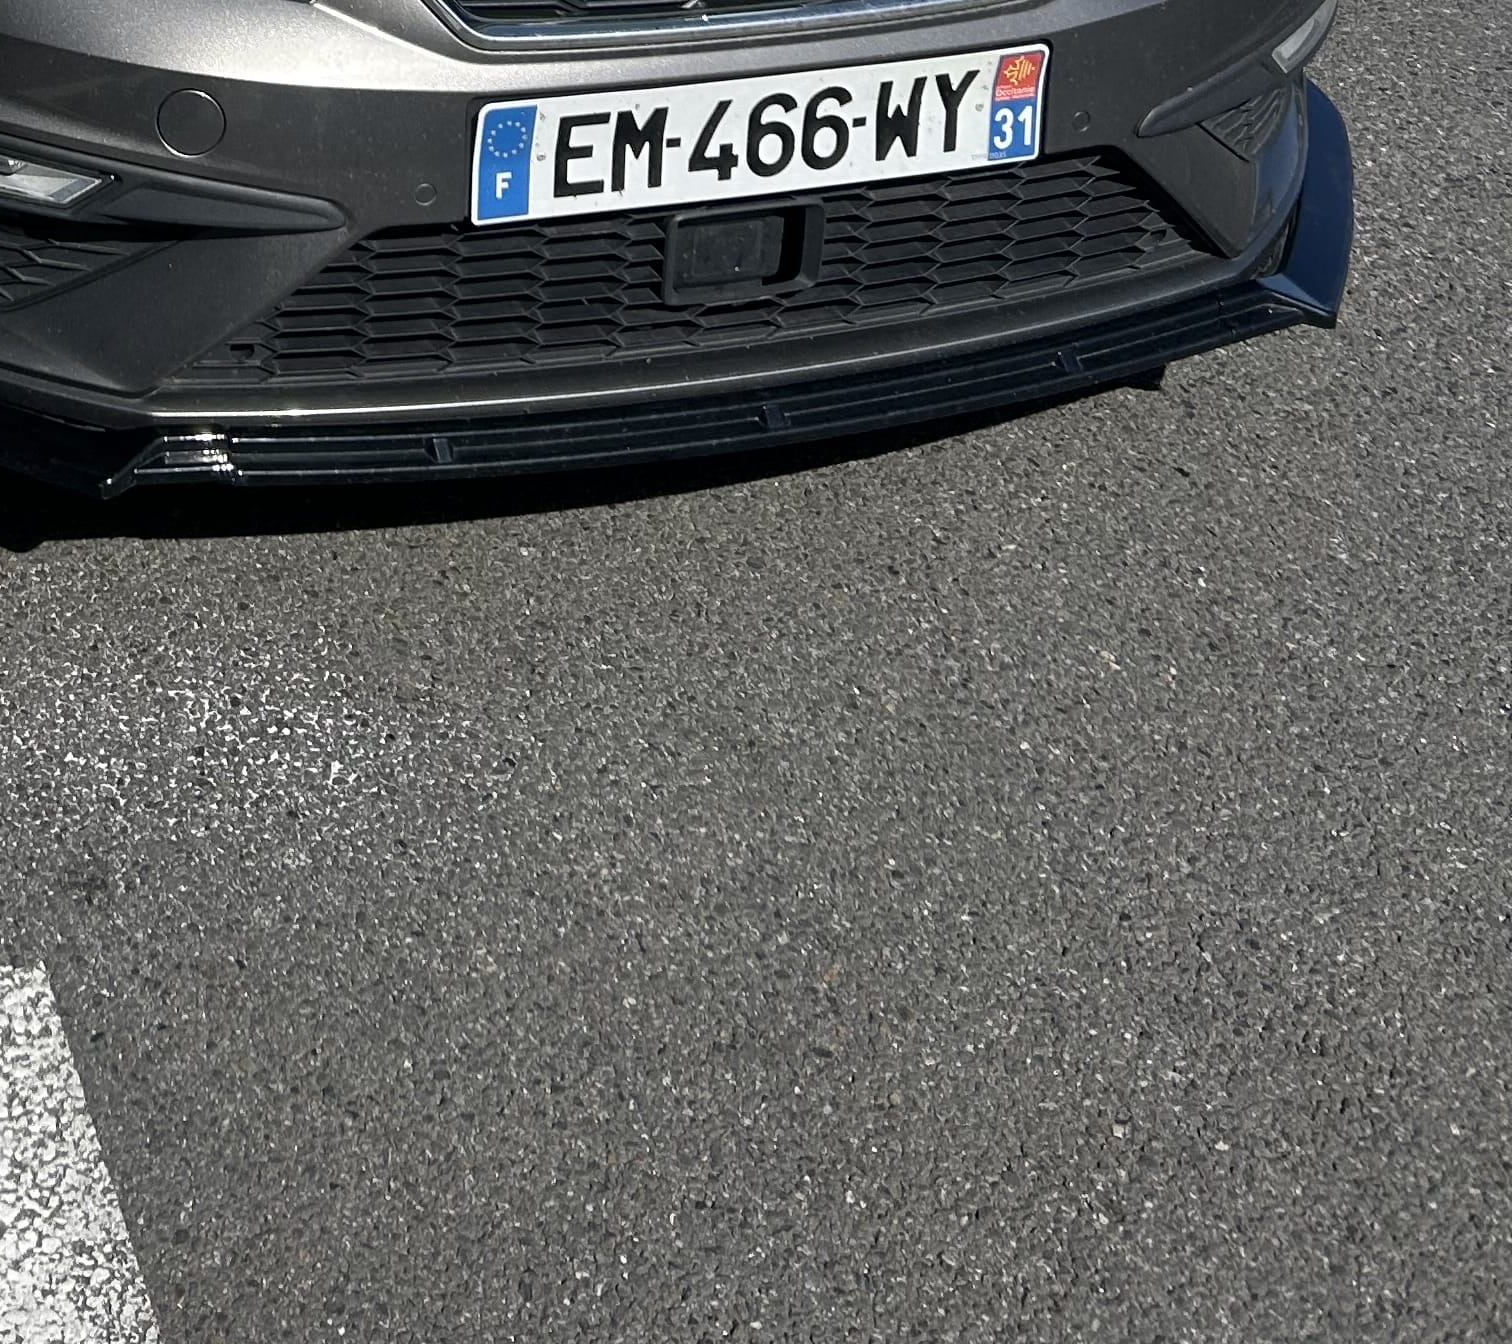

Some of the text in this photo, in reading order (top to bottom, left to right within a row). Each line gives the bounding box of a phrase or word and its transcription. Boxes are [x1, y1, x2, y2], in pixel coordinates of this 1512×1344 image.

[495, 69, 1033, 200] F EM-466-WY 31
